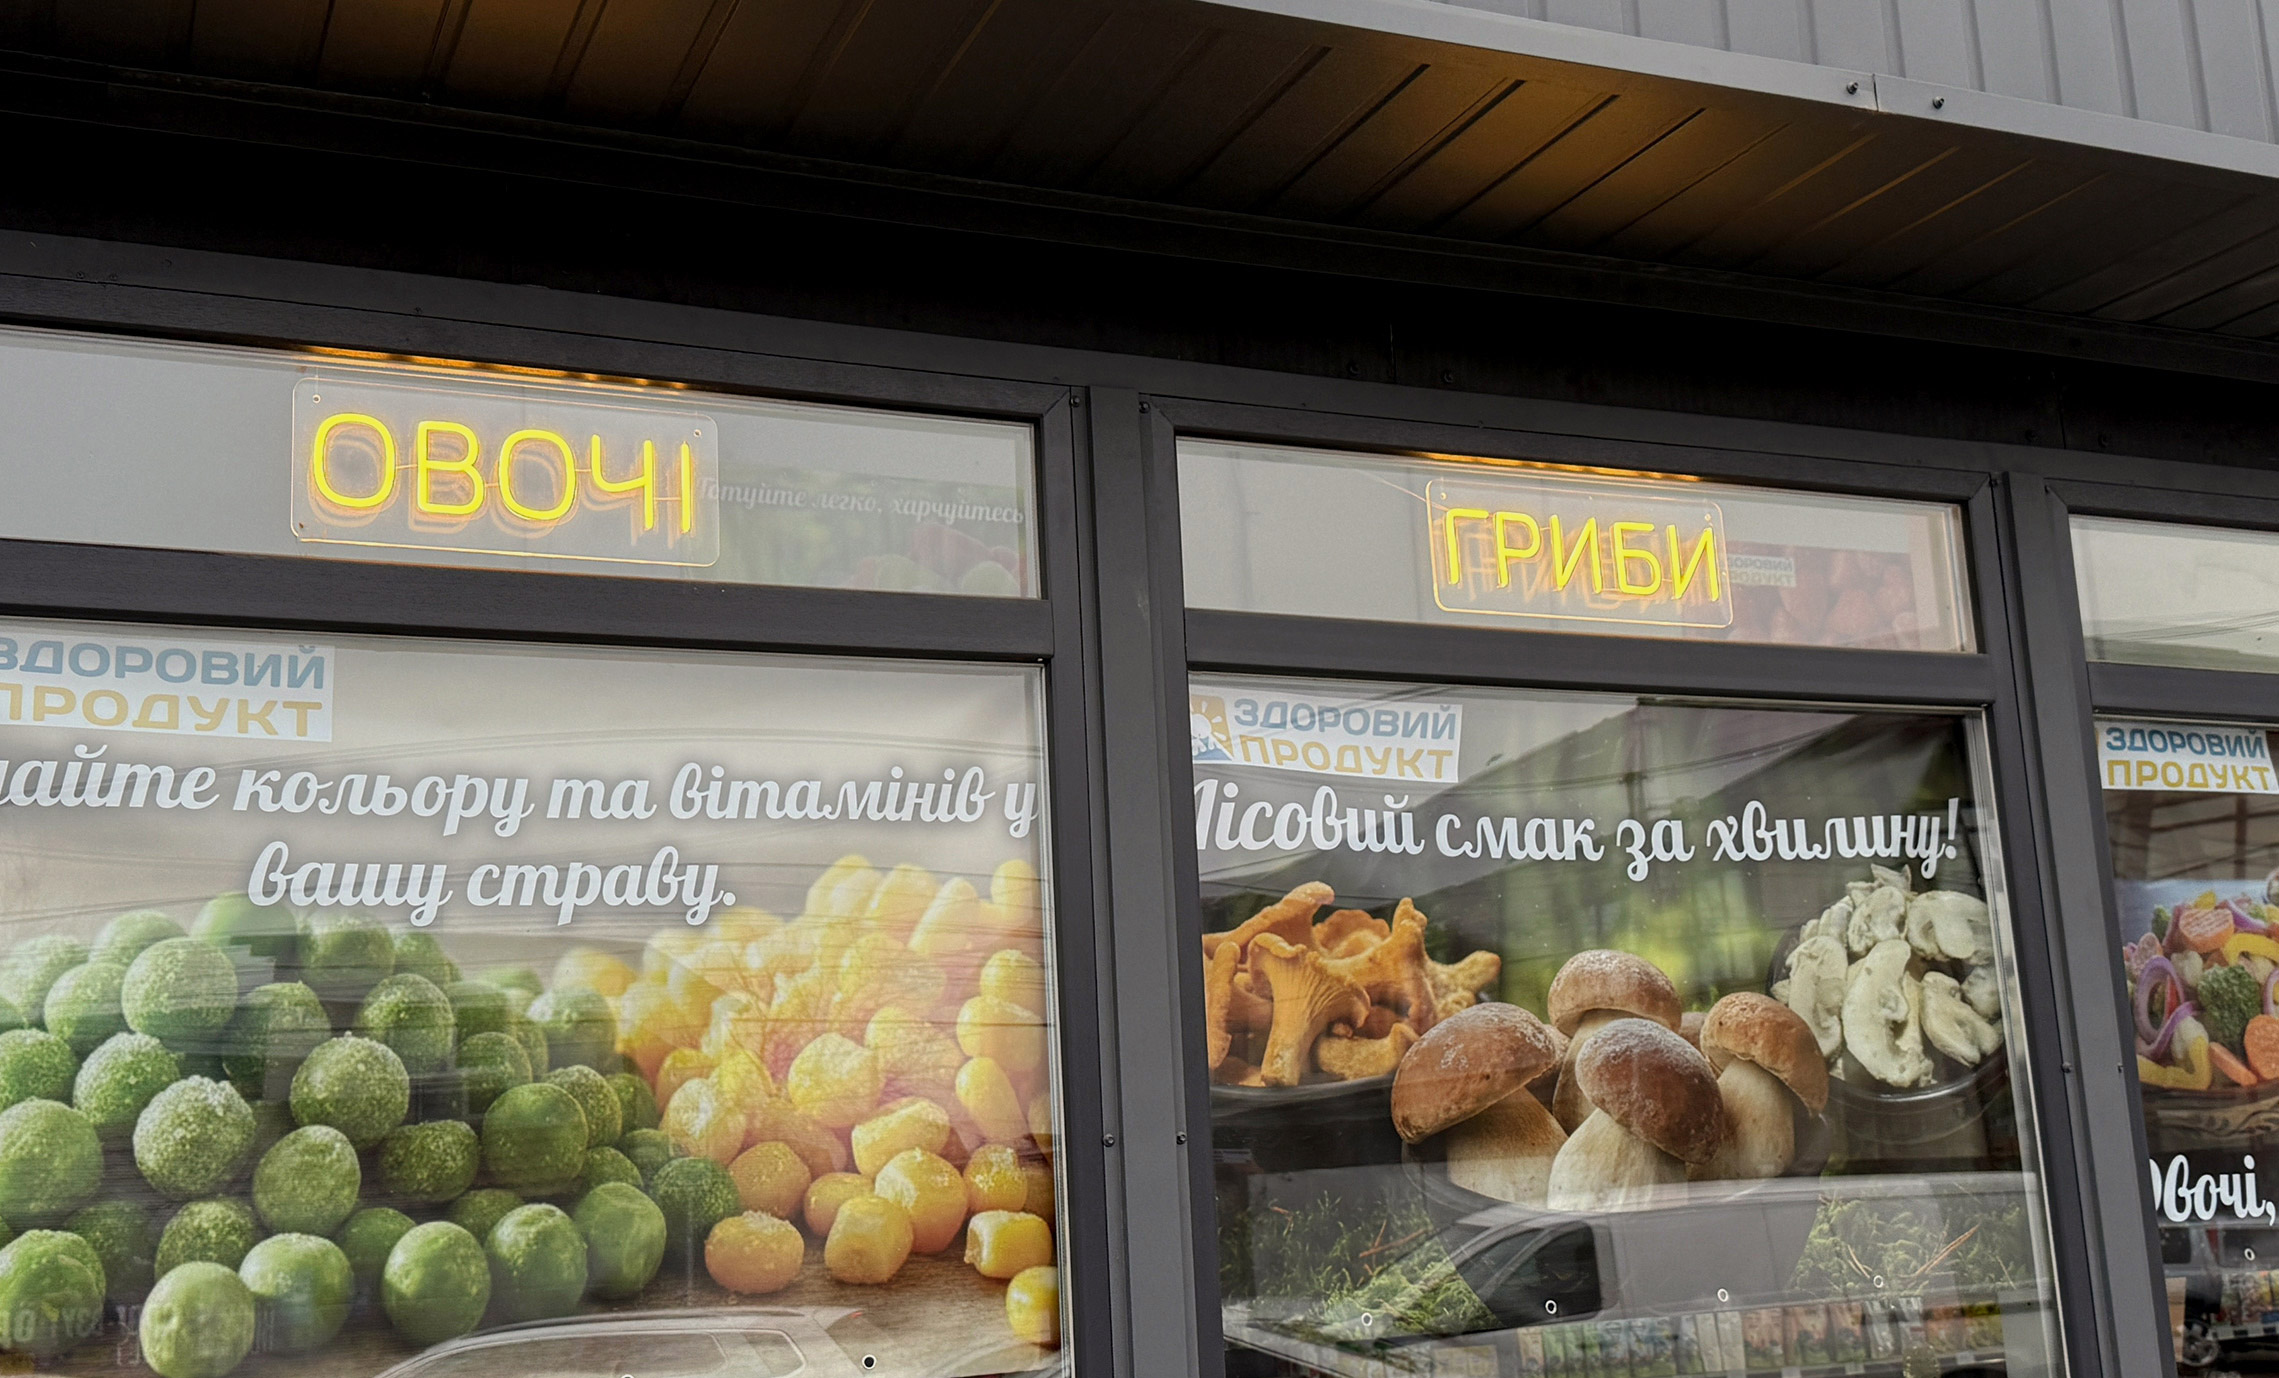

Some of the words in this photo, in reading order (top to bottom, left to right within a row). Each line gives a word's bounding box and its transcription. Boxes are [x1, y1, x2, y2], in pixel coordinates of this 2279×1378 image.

[312, 412, 692, 534] ОВОЧІ
[1444, 507, 1720, 602] ГРИБИ
[1234, 697, 1457, 741] ЗДОРОВИЙ
[1238, 733, 1453, 780] ПРОДУКТ
[2105, 727, 2266, 759] ЗДОРОВИЙ
[232, 768, 535, 837] кольору
[546, 778, 657, 819] та
[669, 762, 996, 823] вітамінів
[1003, 782, 1039, 838] у
[2106, 759, 2270, 791] ПРОДУКТ
[1435, 812, 1604, 862] смак
[1616, 818, 1695, 882] за
[1705, 797, 1959, 880] хвилину!
[247, 840, 453, 927] вашу
[466, 846, 737, 926] страву.
